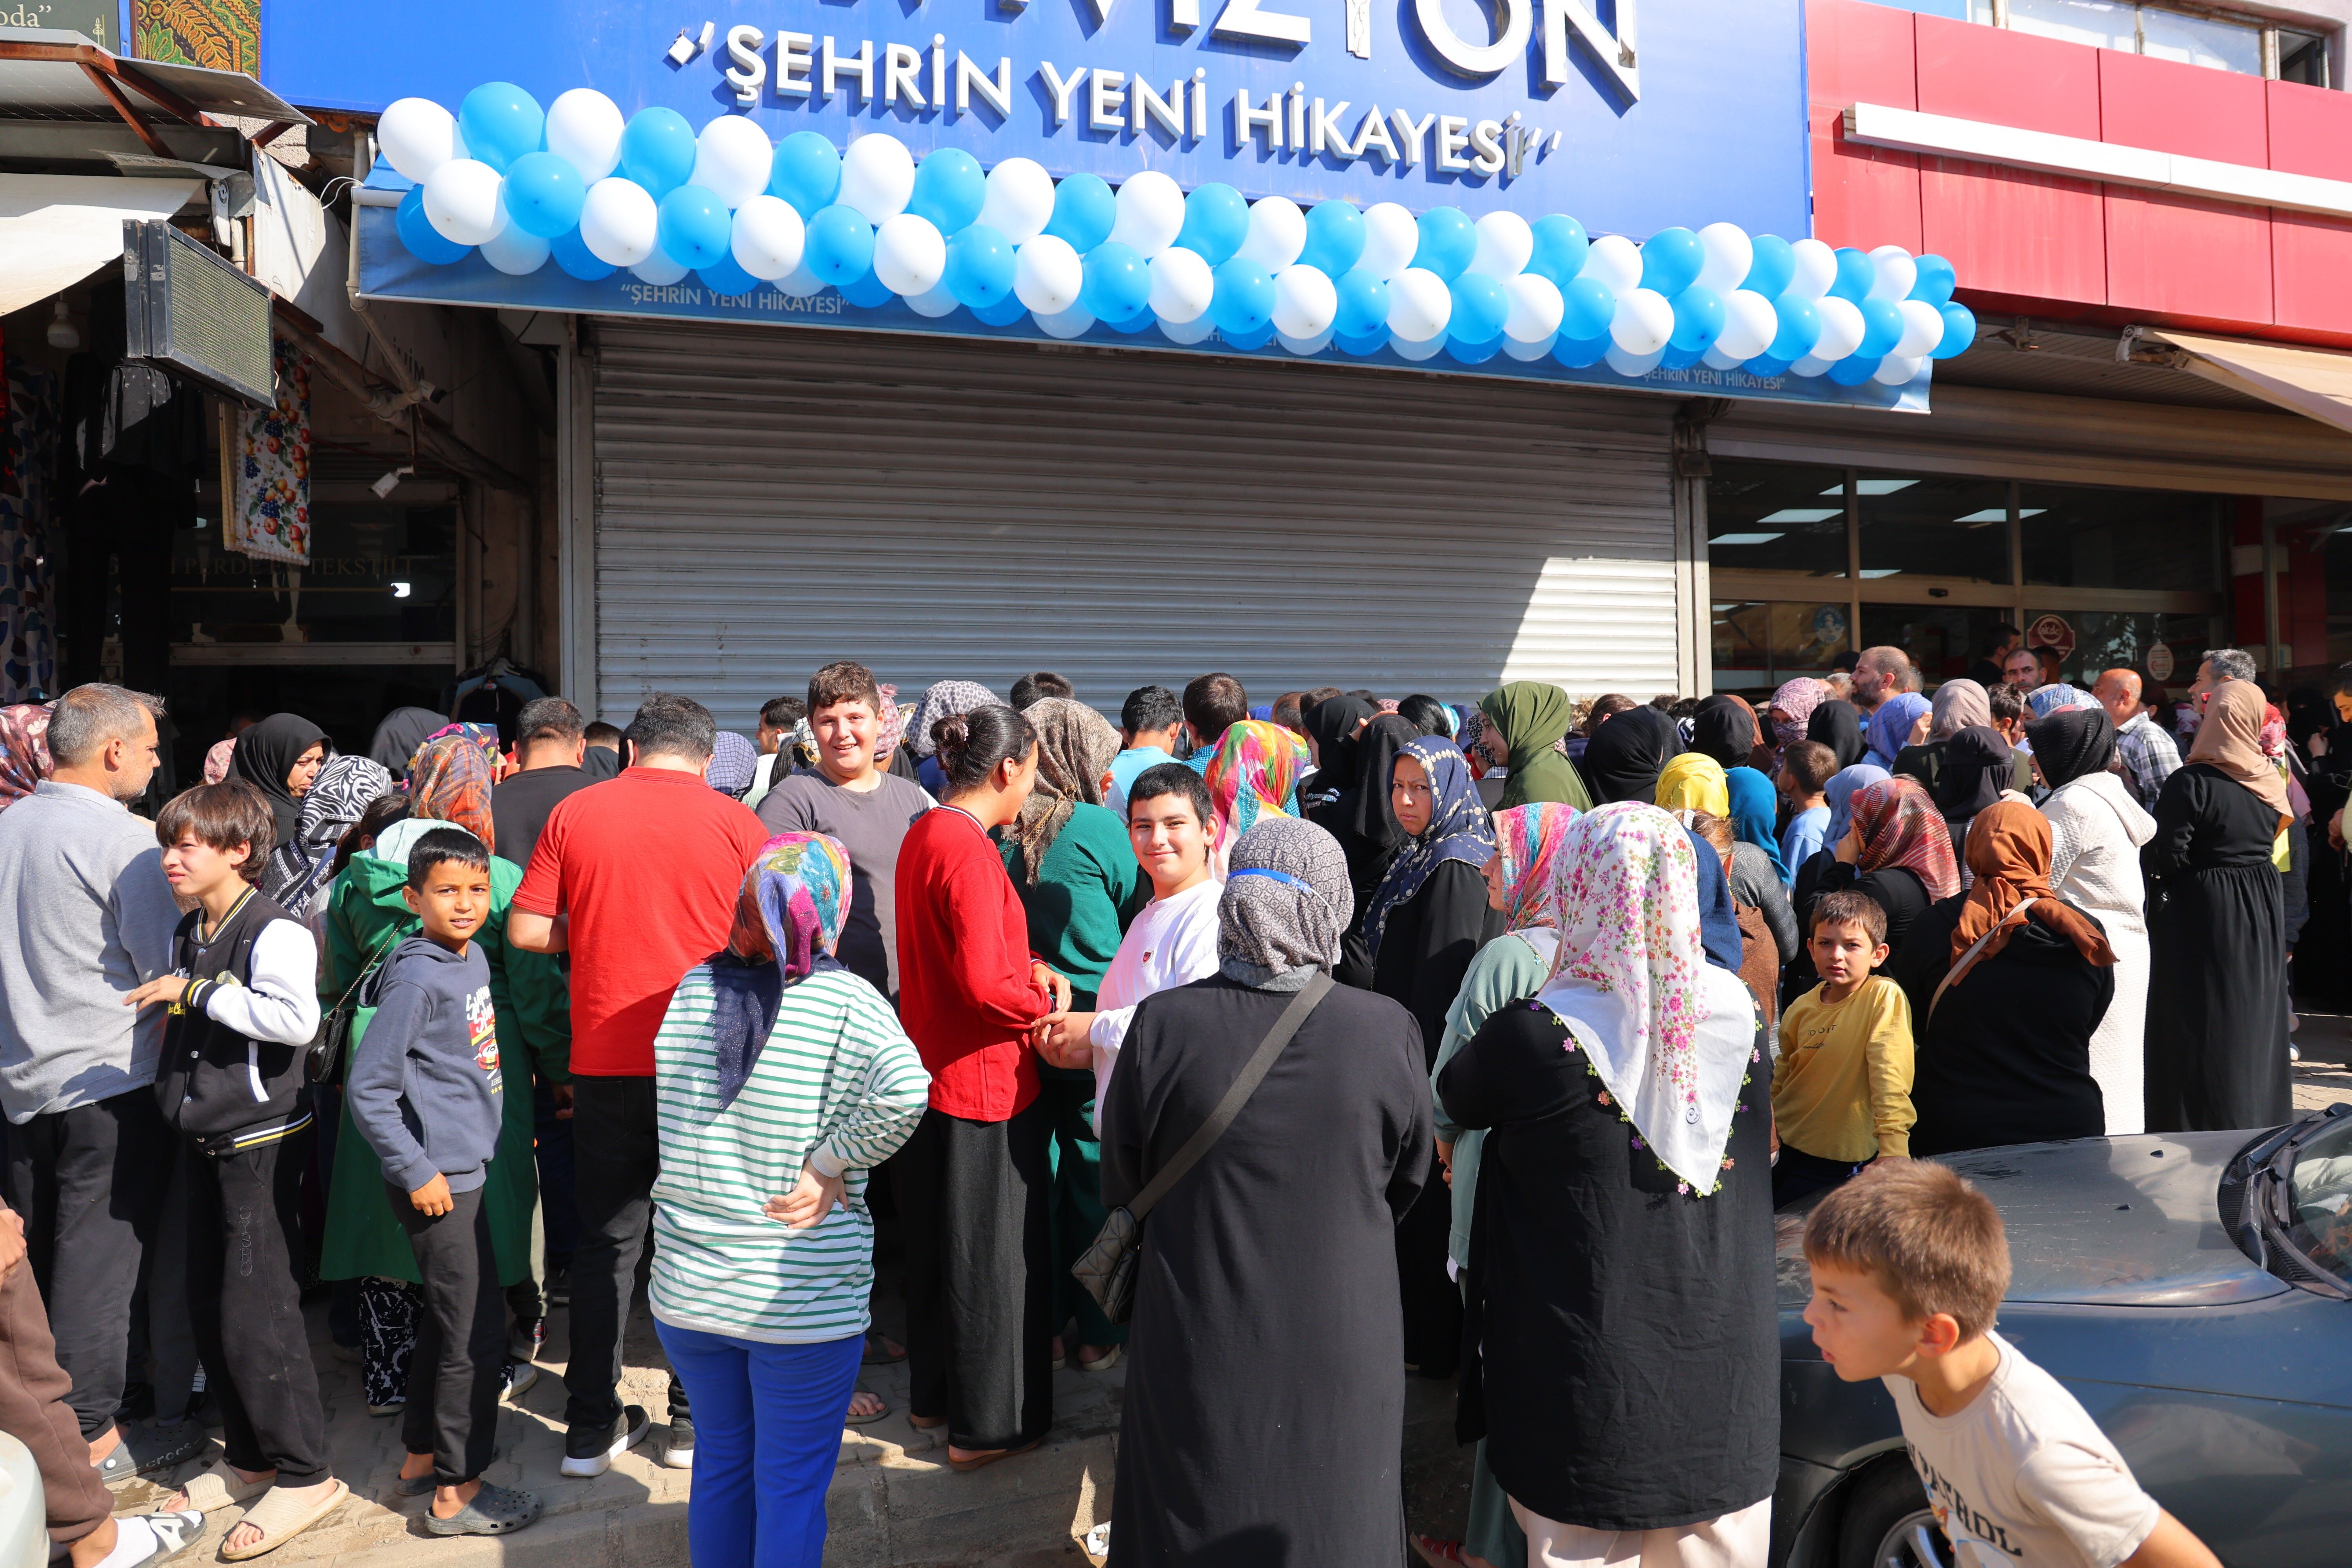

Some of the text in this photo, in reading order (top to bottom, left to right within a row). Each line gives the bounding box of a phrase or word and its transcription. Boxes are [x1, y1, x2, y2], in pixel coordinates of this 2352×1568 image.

[1039, 60, 1206, 142] YENİ
[186, 557, 261, 574] PERDE
[239, 1206, 252, 1276] OYSHO
